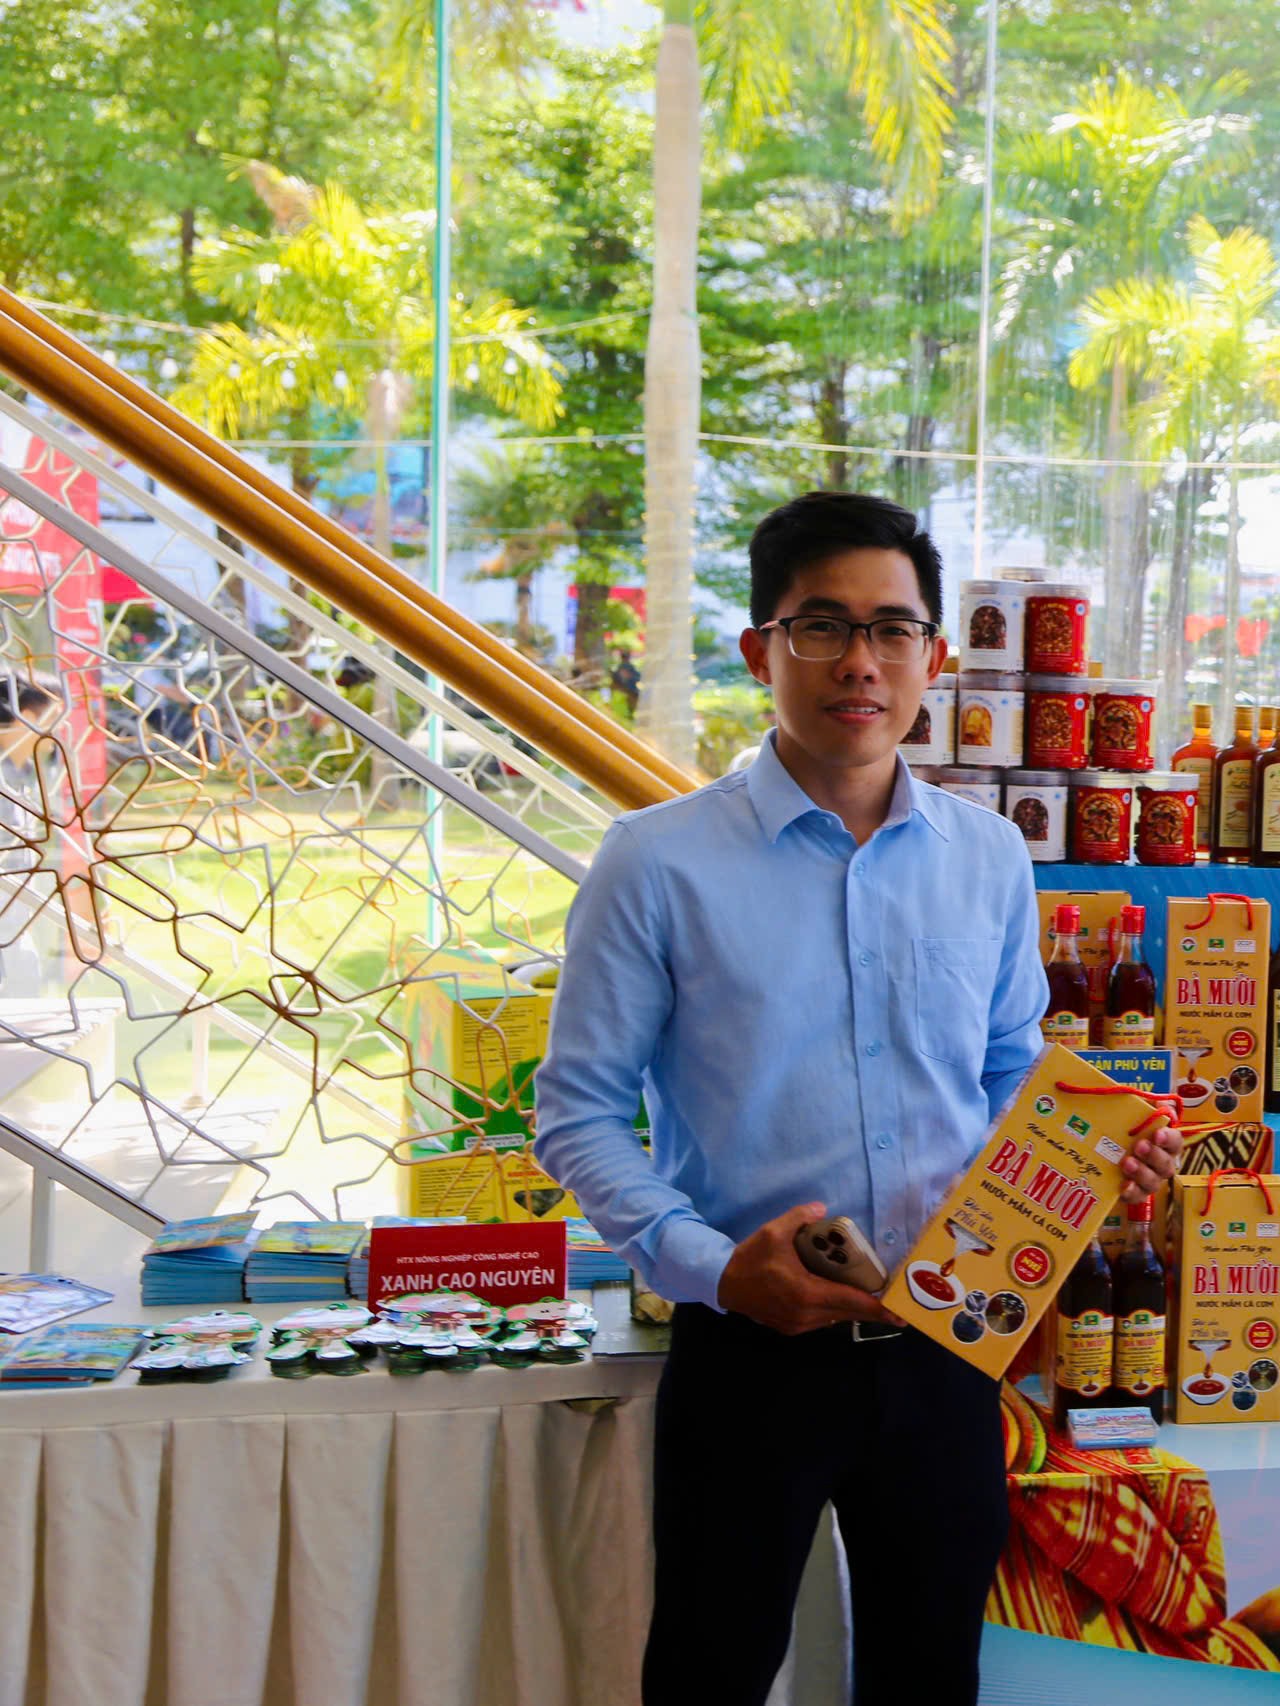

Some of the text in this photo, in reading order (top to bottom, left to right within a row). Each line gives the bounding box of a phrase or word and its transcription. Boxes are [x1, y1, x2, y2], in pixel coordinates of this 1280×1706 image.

[1176, 970, 1202, 1006] BÀ
[1207, 971, 1257, 1007] MƯỜI
[1114, 1056, 1139, 1071] PHÚ
[1142, 1056, 1167, 1071] YÊN
[984, 1135, 1101, 1232] BÀ MƯỜI
[980, 1179, 1069, 1242] NƯỚC MẮM CÁ CƠM
[396, 1256, 414, 1264] HTX
[415, 1254, 440, 1263] NÔNG
[473, 1252, 497, 1261] CÔNG
[521, 1251, 540, 1259] CAO
[381, 1265, 556, 1292] XANH CAO NGUYÊN
[1191, 1257, 1221, 1297] BÀ
[1226, 1257, 1280, 1297] MƯỜI
